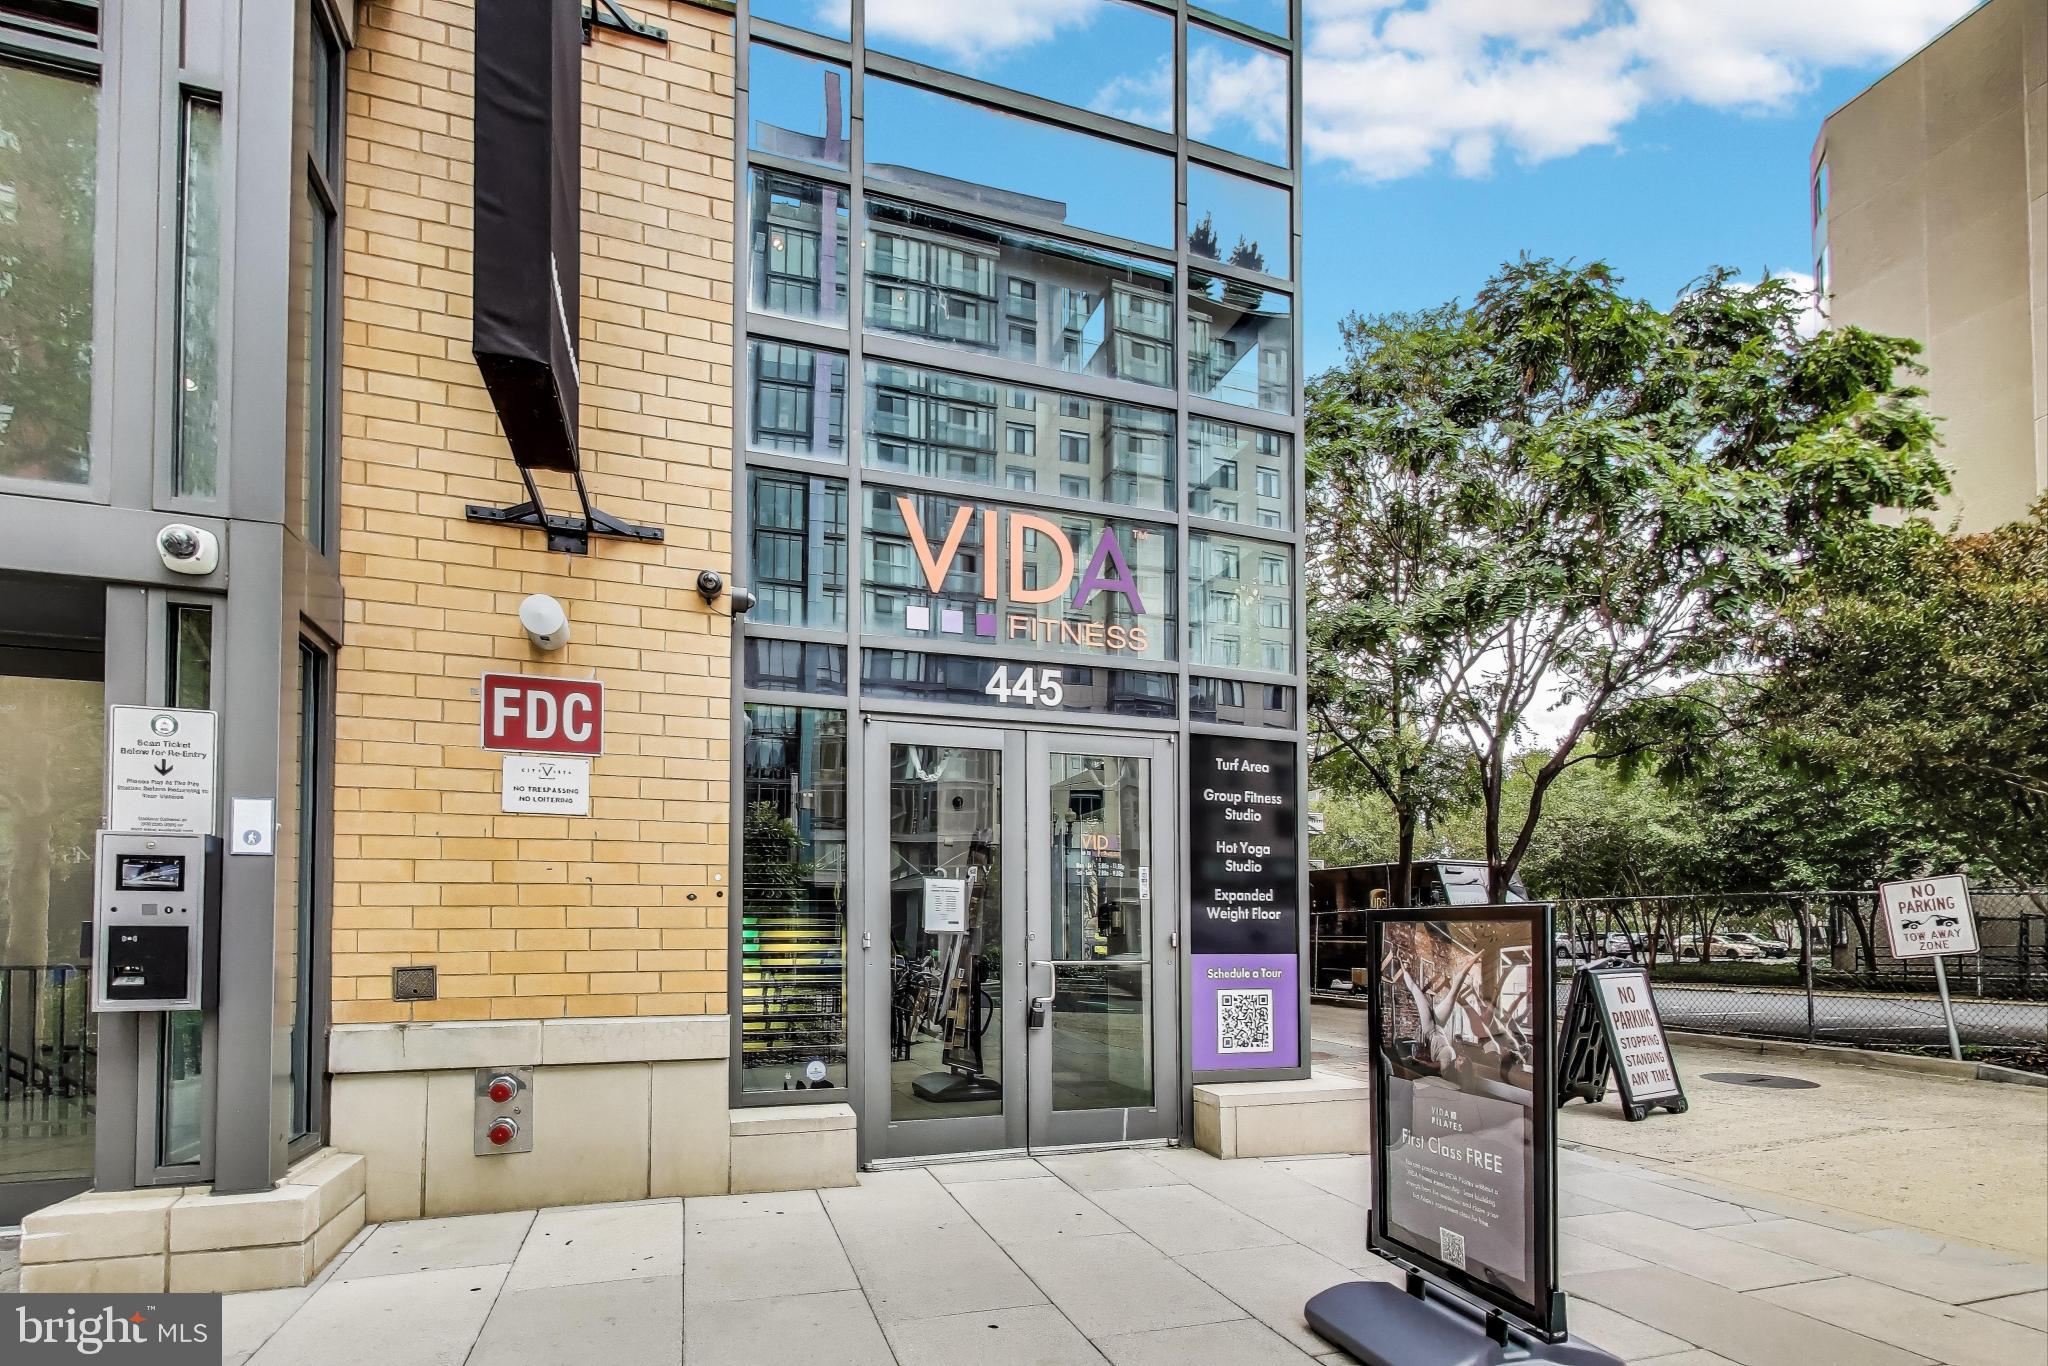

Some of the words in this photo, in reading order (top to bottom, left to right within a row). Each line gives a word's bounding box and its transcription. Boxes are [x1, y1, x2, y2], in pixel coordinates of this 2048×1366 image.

[897, 497, 1146, 614] VIDA
[1008, 615, 1149, 651] FITNESS
[985, 665, 1063, 706] 445
[493, 687, 593, 742] FDC
[120, 747, 149, 755] Below
[151, 748, 166, 756] for
[137, 739, 160, 747] Scan
[163, 740, 191, 749] Ticket
[1215, 757, 1239, 771] Turf
[1241, 759, 1270, 773] Area
[528, 786, 579, 795] TRESPASSING
[1203, 788, 1241, 805] Group
[1244, 790, 1282, 805] Fitness
[533, 796, 574, 804] LOITERING
[1225, 807, 1262, 822] Studio
[1216, 841, 1238, 854] Hot
[1239, 841, 1271, 858] Yoga
[1225, 860, 1262, 873] Studio
[1214, 888, 1274, 904] Expanded
[1911, 883, 1936, 898] NO
[1898, 896, 1955, 914] PARKING
[1206, 906, 1249, 922] Weight
[1252, 907, 1281, 920] Floor
[1903, 931, 1926, 941] TOW
[1931, 928, 1961, 939] AWAY
[1920, 941, 1950, 951] ZONE
[1207, 967, 1250, 979] Schedule
[1261, 967, 1282, 978] Tour
[1617, 986, 1636, 1004] NO
[1612, 1008, 1654, 1031] PARKING
[1620, 1034, 1660, 1049] STOPPING
[1625, 1051, 1665, 1067] STANDING
[1631, 1071, 1651, 1086] ANY
[1652, 1068, 1671, 1083] TIME
[1431, 1106, 1450, 1119] VIDA
[1431, 1117, 1463, 1132] PILATES
[1401, 1127, 1424, 1149] First
[1428, 1136, 1463, 1161] Class
[1466, 1147, 1503, 1174] FREE
